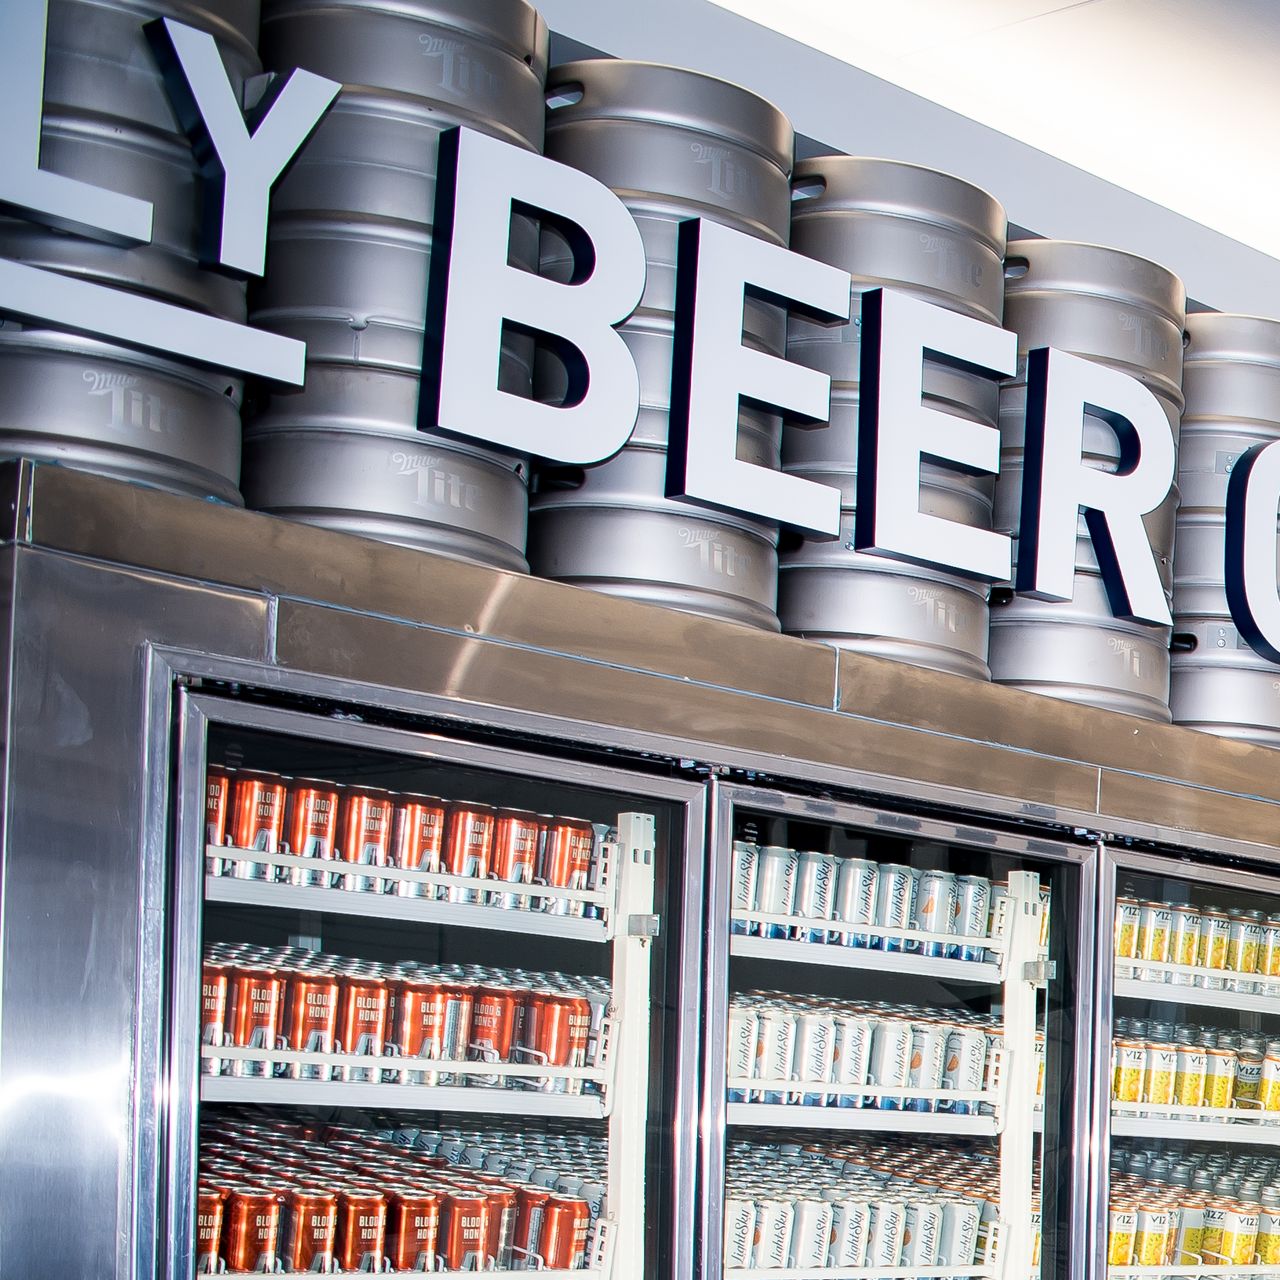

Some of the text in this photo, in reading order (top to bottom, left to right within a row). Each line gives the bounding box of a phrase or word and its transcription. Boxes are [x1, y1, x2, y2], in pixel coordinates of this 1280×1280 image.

[416, 125, 1174, 627] BEER
[308, 1006, 331, 1019] HONE
[358, 1010, 380, 1022] HONE
[1238, 1065, 1262, 1077] VIZZ
